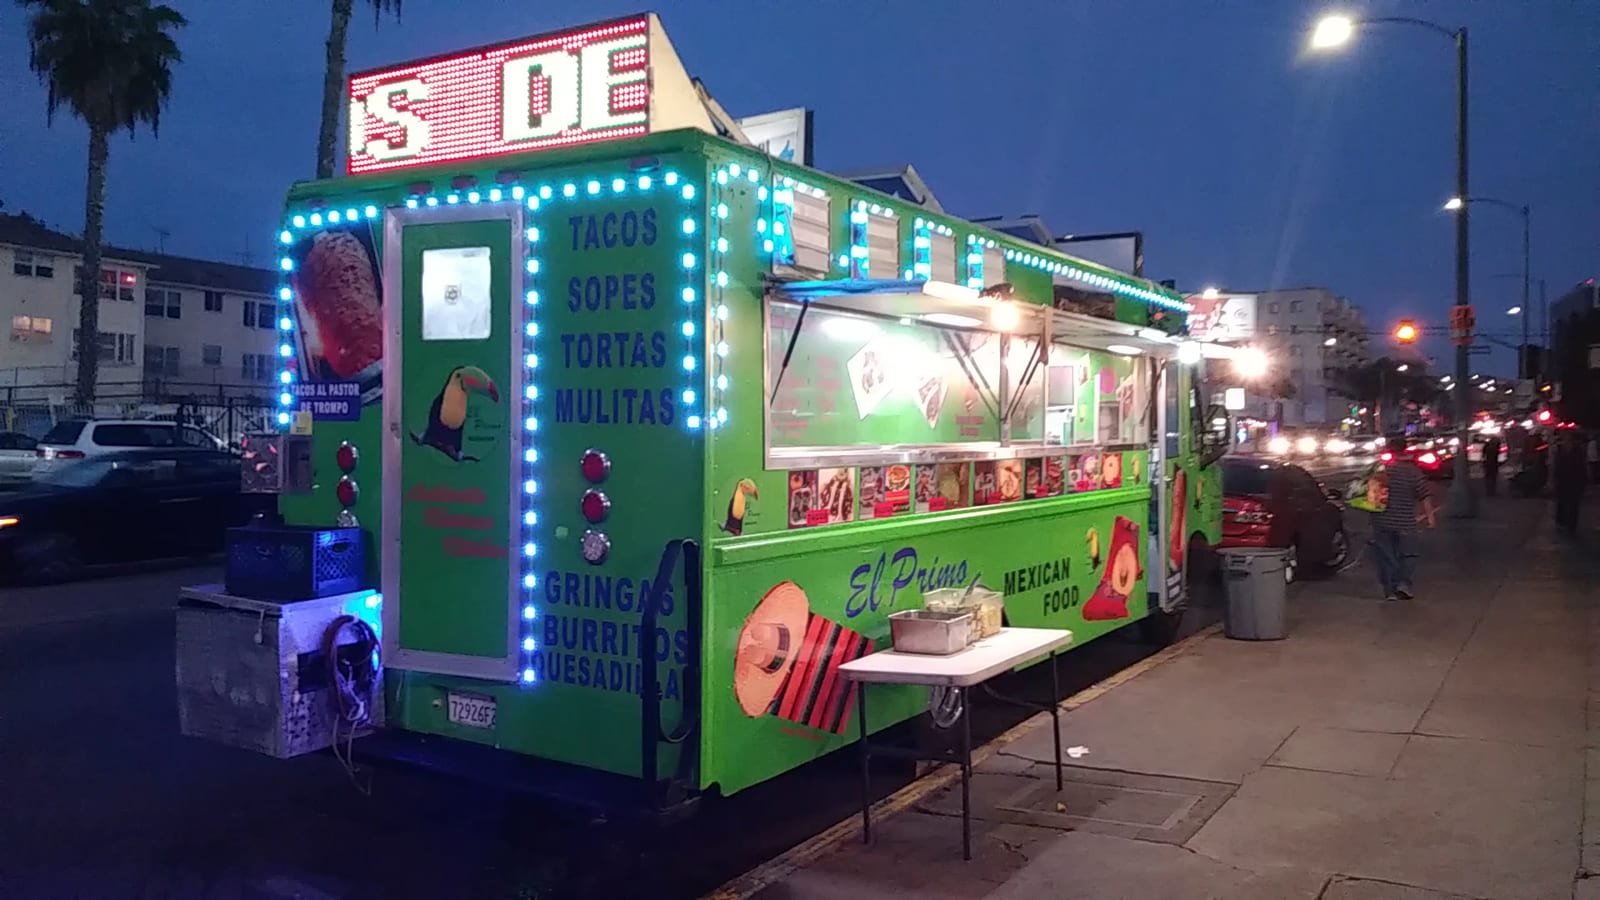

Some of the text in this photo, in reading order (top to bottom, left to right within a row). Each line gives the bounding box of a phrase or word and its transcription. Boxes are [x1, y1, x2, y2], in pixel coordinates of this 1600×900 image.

[502, 34, 647, 142] DE
[569, 208, 658, 250] TACOS
[568, 272, 656, 312] SOPES
[561, 330, 667, 369] TORTAS
[314, 401, 349, 414] TROMPO
[317, 384, 327, 396] AL
[329, 383, 360, 396] PASTOR
[555, 387, 675, 426] MULITAS
[845, 546, 967, 618] El Primo
[1003, 557, 1071, 597] MEXICAN
[1043, 585, 1079, 616] FOOD
[544, 614, 688, 666] BURRITOS
